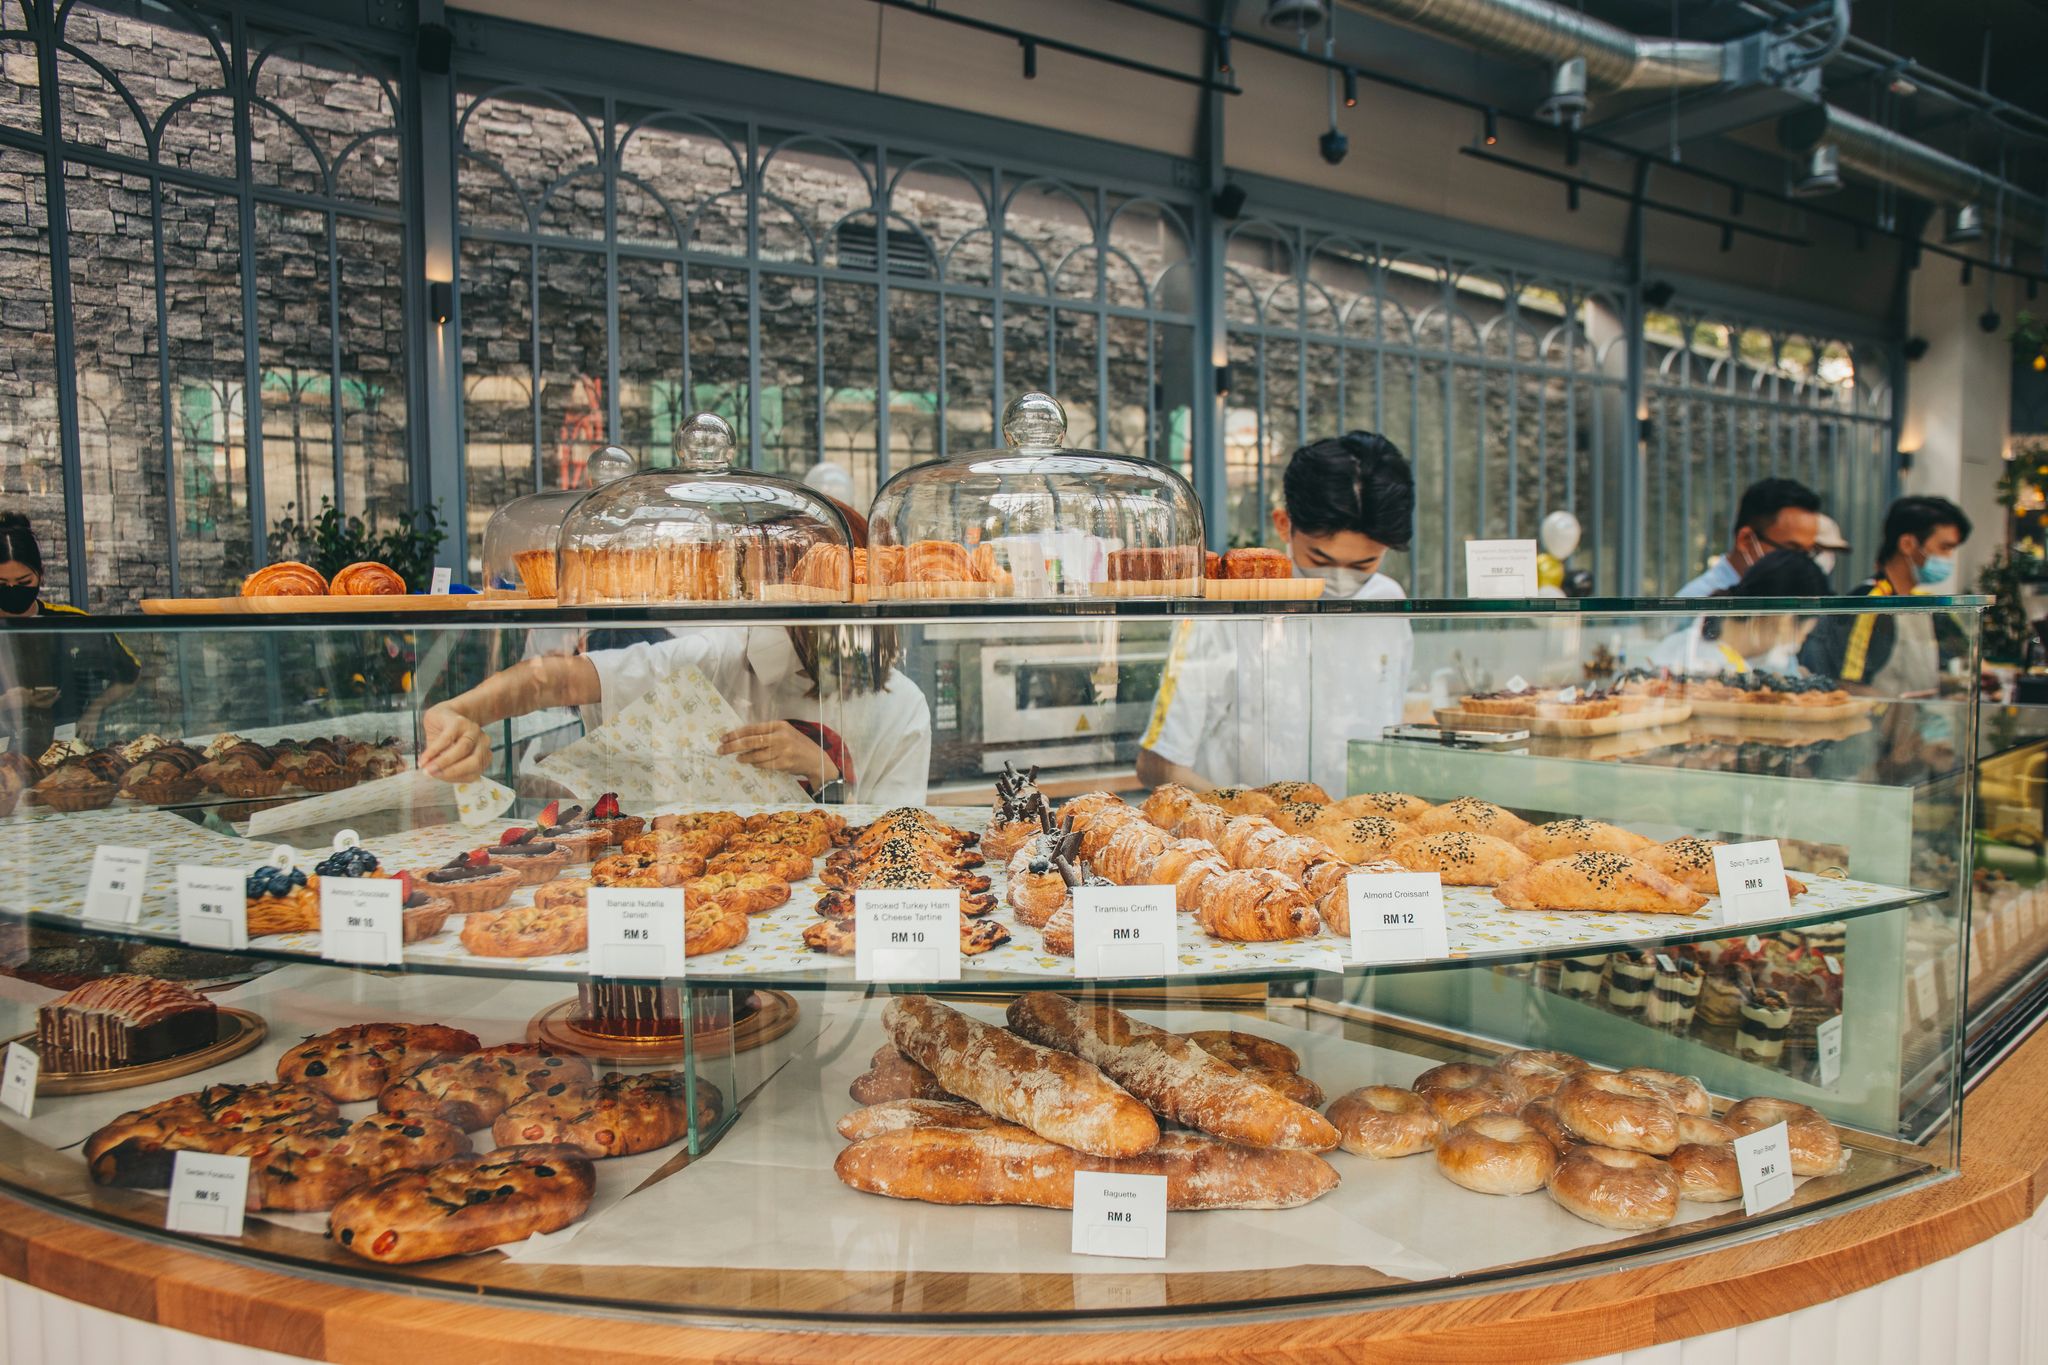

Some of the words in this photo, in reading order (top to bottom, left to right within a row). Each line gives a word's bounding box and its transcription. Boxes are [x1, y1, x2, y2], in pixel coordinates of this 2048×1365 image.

[1745, 879, 1757, 889] RM
[1758, 879, 1763, 888] 8
[1363, 891, 1392, 899] Almond
[1394, 890, 1429, 898] Croissant
[638, 900, 664, 908] Nutella
[865, 902, 899, 910] Smoked
[902, 902, 928, 911] Turkey
[1094, 905, 1128, 913] Tiramisu
[1130, 904, 1158, 912] Cruffin
[623, 911, 649, 919] Danish
[881, 913, 912, 921] Cheese
[915, 913, 942, 921] Tartine
[1383, 914, 1400, 924] RM
[1402, 913, 1414, 924] 12
[348, 916, 361, 926] RM
[624, 929, 639, 939] RM
[642, 929, 649, 940] 8
[891, 932, 908, 942] RM
[912, 932, 925, 942] 10
[1113, 929, 1130, 939] RM
[1133, 928, 1140, 939] 8
[1761, 1166, 1770, 1177] RM
[195, 1190, 209, 1200] RM
[1103, 1189, 1137, 1198] Baguette
[1107, 1211, 1123, 1222] RM
[1125, 1212, 1132, 1222] 8
